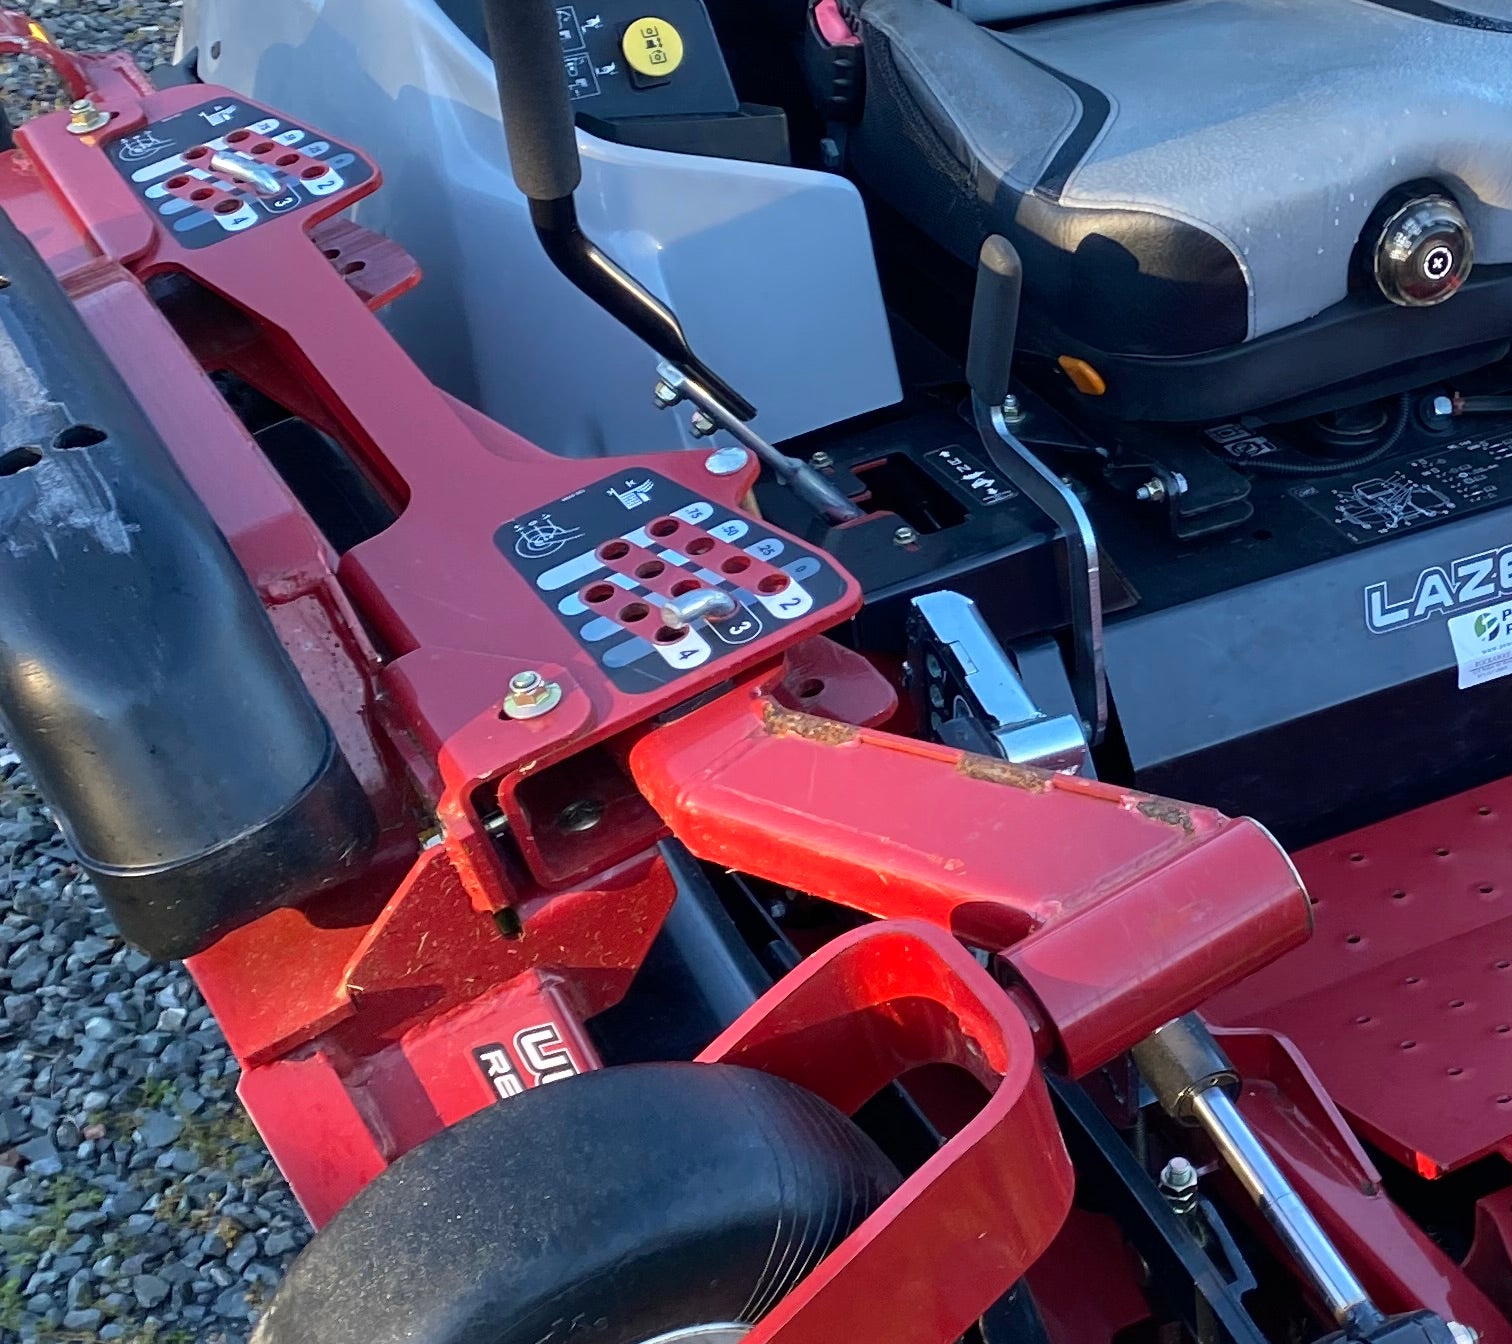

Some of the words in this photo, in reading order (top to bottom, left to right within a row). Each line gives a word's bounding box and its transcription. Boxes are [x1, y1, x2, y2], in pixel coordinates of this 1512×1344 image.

[780, 597, 801, 611] 2
[728, 621, 753, 635] 3
[679, 648, 700, 661] 4
